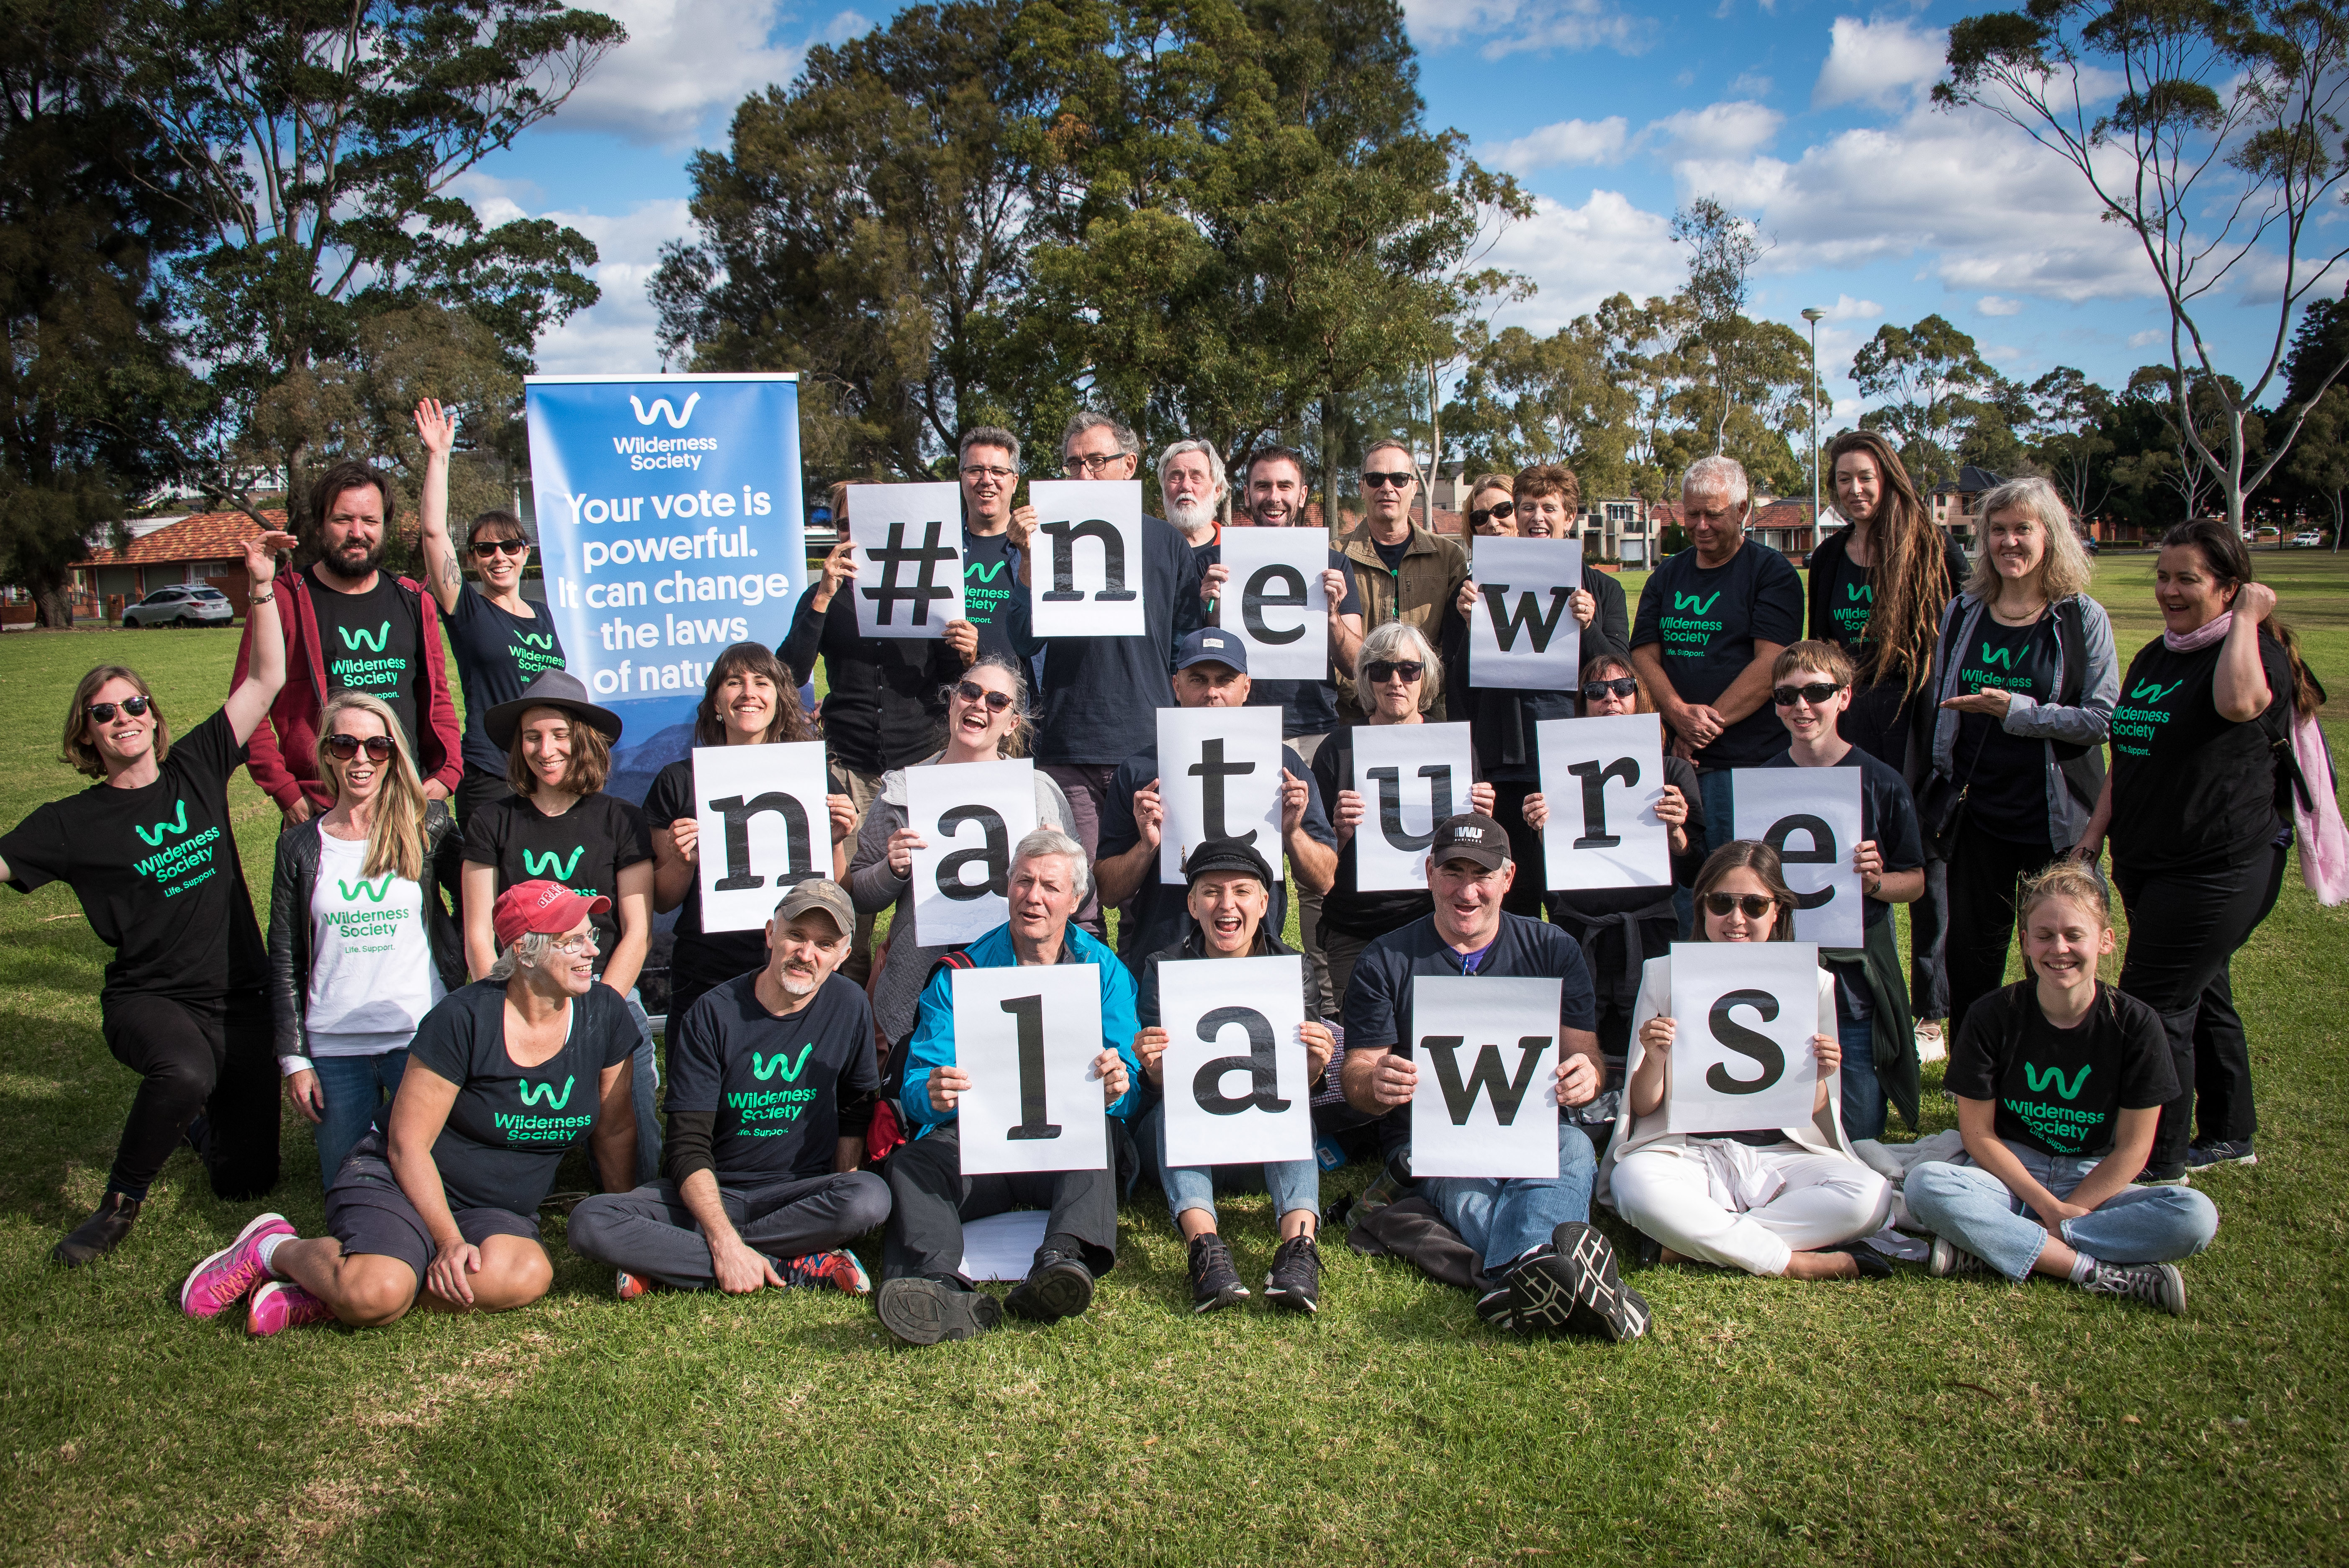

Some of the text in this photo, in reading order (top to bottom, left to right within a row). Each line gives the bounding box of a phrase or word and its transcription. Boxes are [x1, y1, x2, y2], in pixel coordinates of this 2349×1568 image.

[614, 436, 718, 455] Wilderness
[631, 453, 703, 471] Society
[564, 485, 772, 525] Your vote is
[584, 526, 758, 573] powerful.
[1040, 520, 1136, 601] n
[861, 522, 958, 626] #
[558, 570, 789, 609] It can change
[965, 597, 997, 612] ciety
[1242, 564, 1307, 644] e
[601, 614, 748, 650] the laws
[1478, 584, 1576, 653] w
[1659, 617, 1722, 631] Wilderness
[1664, 629, 1710, 646] Society
[331, 657, 406, 675] Wilderness
[508, 645, 565, 667] Wilderness
[1677, 649, 1705, 657] Support.
[344, 671, 398, 687] Society
[593, 660, 713, 695] of natu
[2113, 721, 2155, 741] Society
[2118, 744, 2150, 756] Life. Support.
[1188, 738, 1258, 845] t
[1568, 757, 1640, 849] r
[1367, 765, 1453, 852] u
[133, 827, 220, 876] Wilderness
[709, 792, 825, 891] n
[936, 805, 1009, 901] a
[156, 846, 212, 883] Society
[1762, 814, 1836, 910] e
[164, 868, 216, 897] Life. Support.
[324, 908, 409, 926] Wilderness
[340, 923, 397, 937] Society
[362, 944, 395, 953] Support.
[1706, 989, 1785, 1095] s
[1193, 1006, 1291, 1115] a
[1420, 1036, 1553, 1126] w
[728, 1088, 817, 1109] Wilderness
[2004, 1098, 2105, 1124] Wilderness
[495, 1112, 591, 1129] Wilderness
[741, 1104, 803, 1124] Society
[507, 1129, 577, 1141] Society
[2021, 1115, 2089, 1141] Society
[2046, 1137, 2082, 1153] Support.
